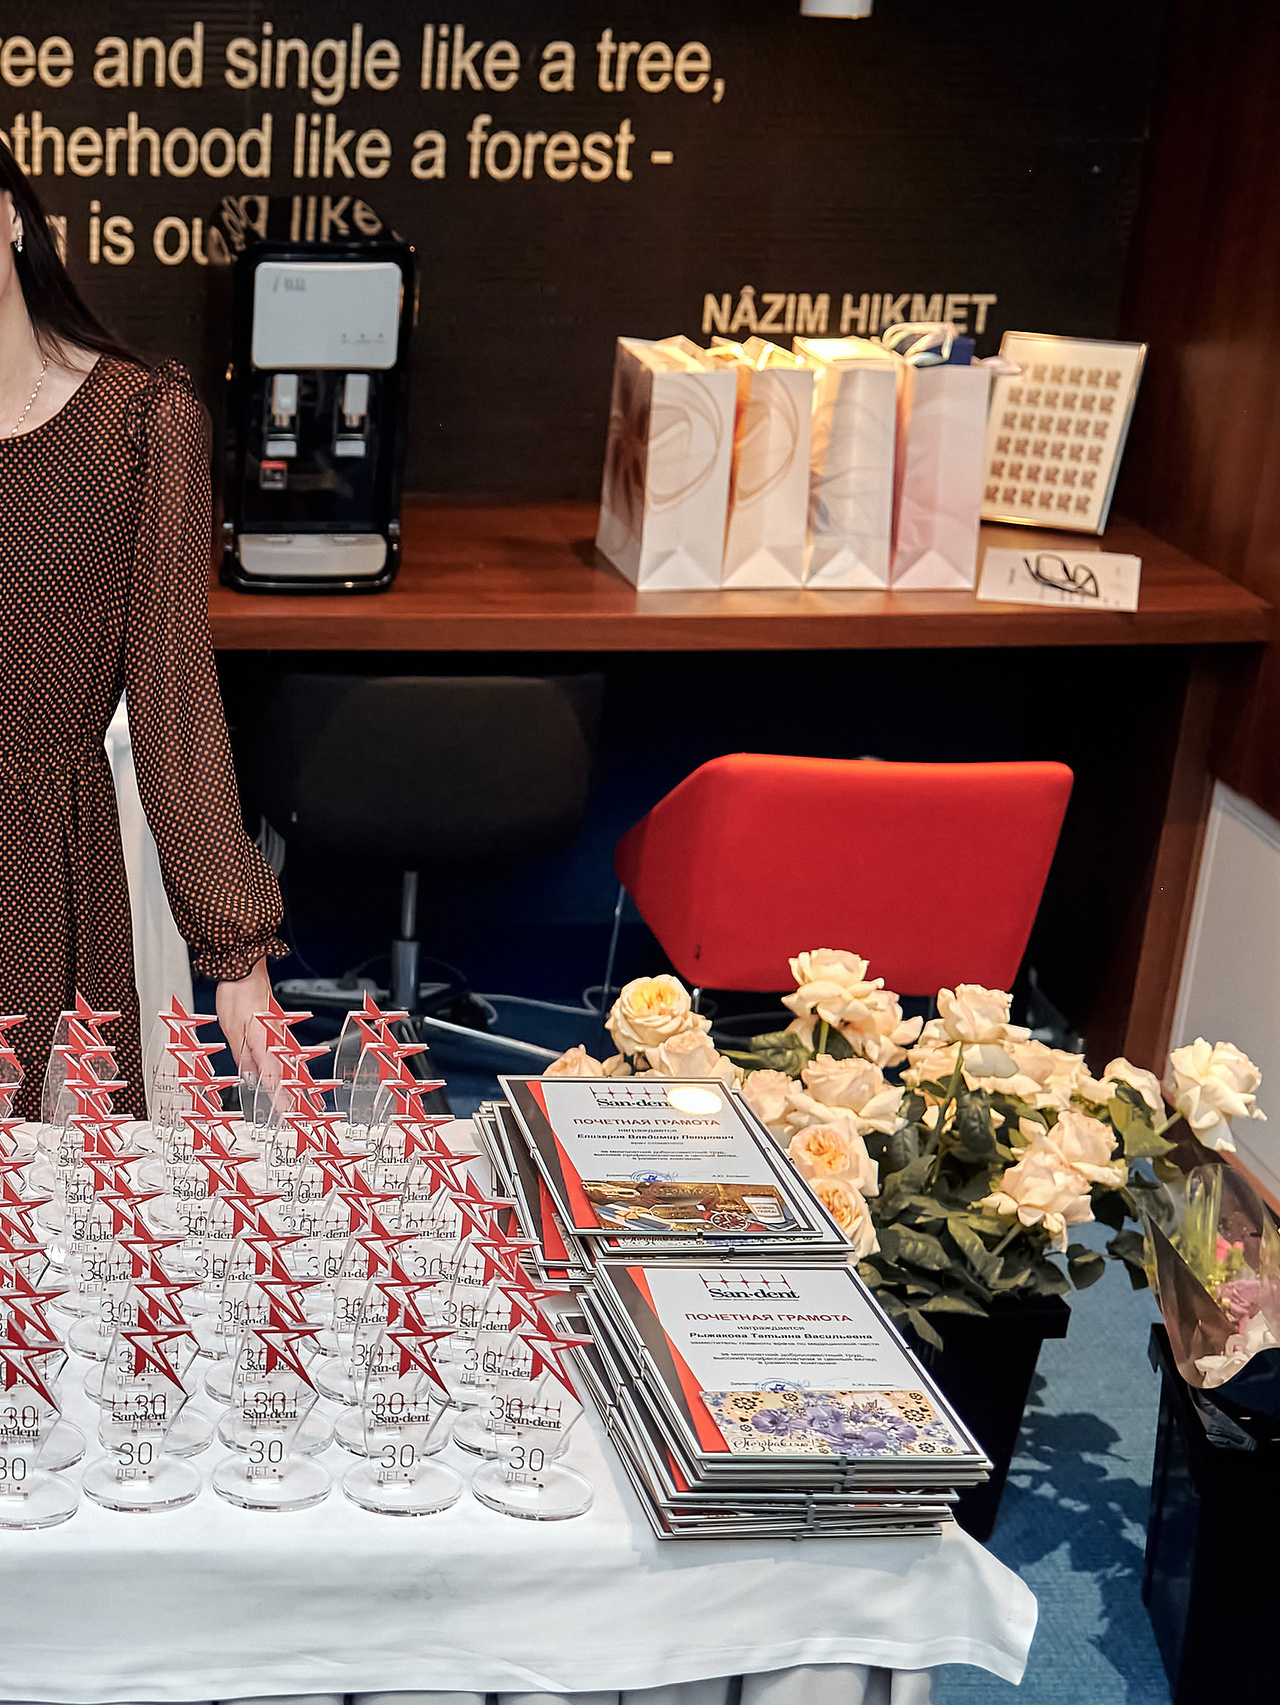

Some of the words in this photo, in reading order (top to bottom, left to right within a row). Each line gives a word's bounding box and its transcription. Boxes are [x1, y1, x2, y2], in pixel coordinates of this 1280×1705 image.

[92, 21, 204, 88] and
[224, 22, 401, 105] single
[421, 23, 520, 92] like
[539, 40, 575, 92] a
[596, 28, 726, 102] tree,
[293, 112, 392, 180] like
[410, 130, 447, 180] a
[467, 113, 635, 182] forest
[88, 200, 135, 265] is
[839, 292, 998, 335] HIKMET
[685, 1313, 774, 1321] ПОЧЕТНАЯ
[777, 1314, 853, 1322] ГРАМОТА
[119, 1442, 153, 1466] 30
[249, 1440, 283, 1463] 30
[381, 1444, 415, 1468] 30
[509, 1446, 545, 1472] 30
[116, 1469, 138, 1478] ЛЕТ
[247, 1467, 269, 1475] ЛЕТ
[378, 1471, 400, 1480] ЛЕТ
[505, 1471, 528, 1482] ЛЕТ
